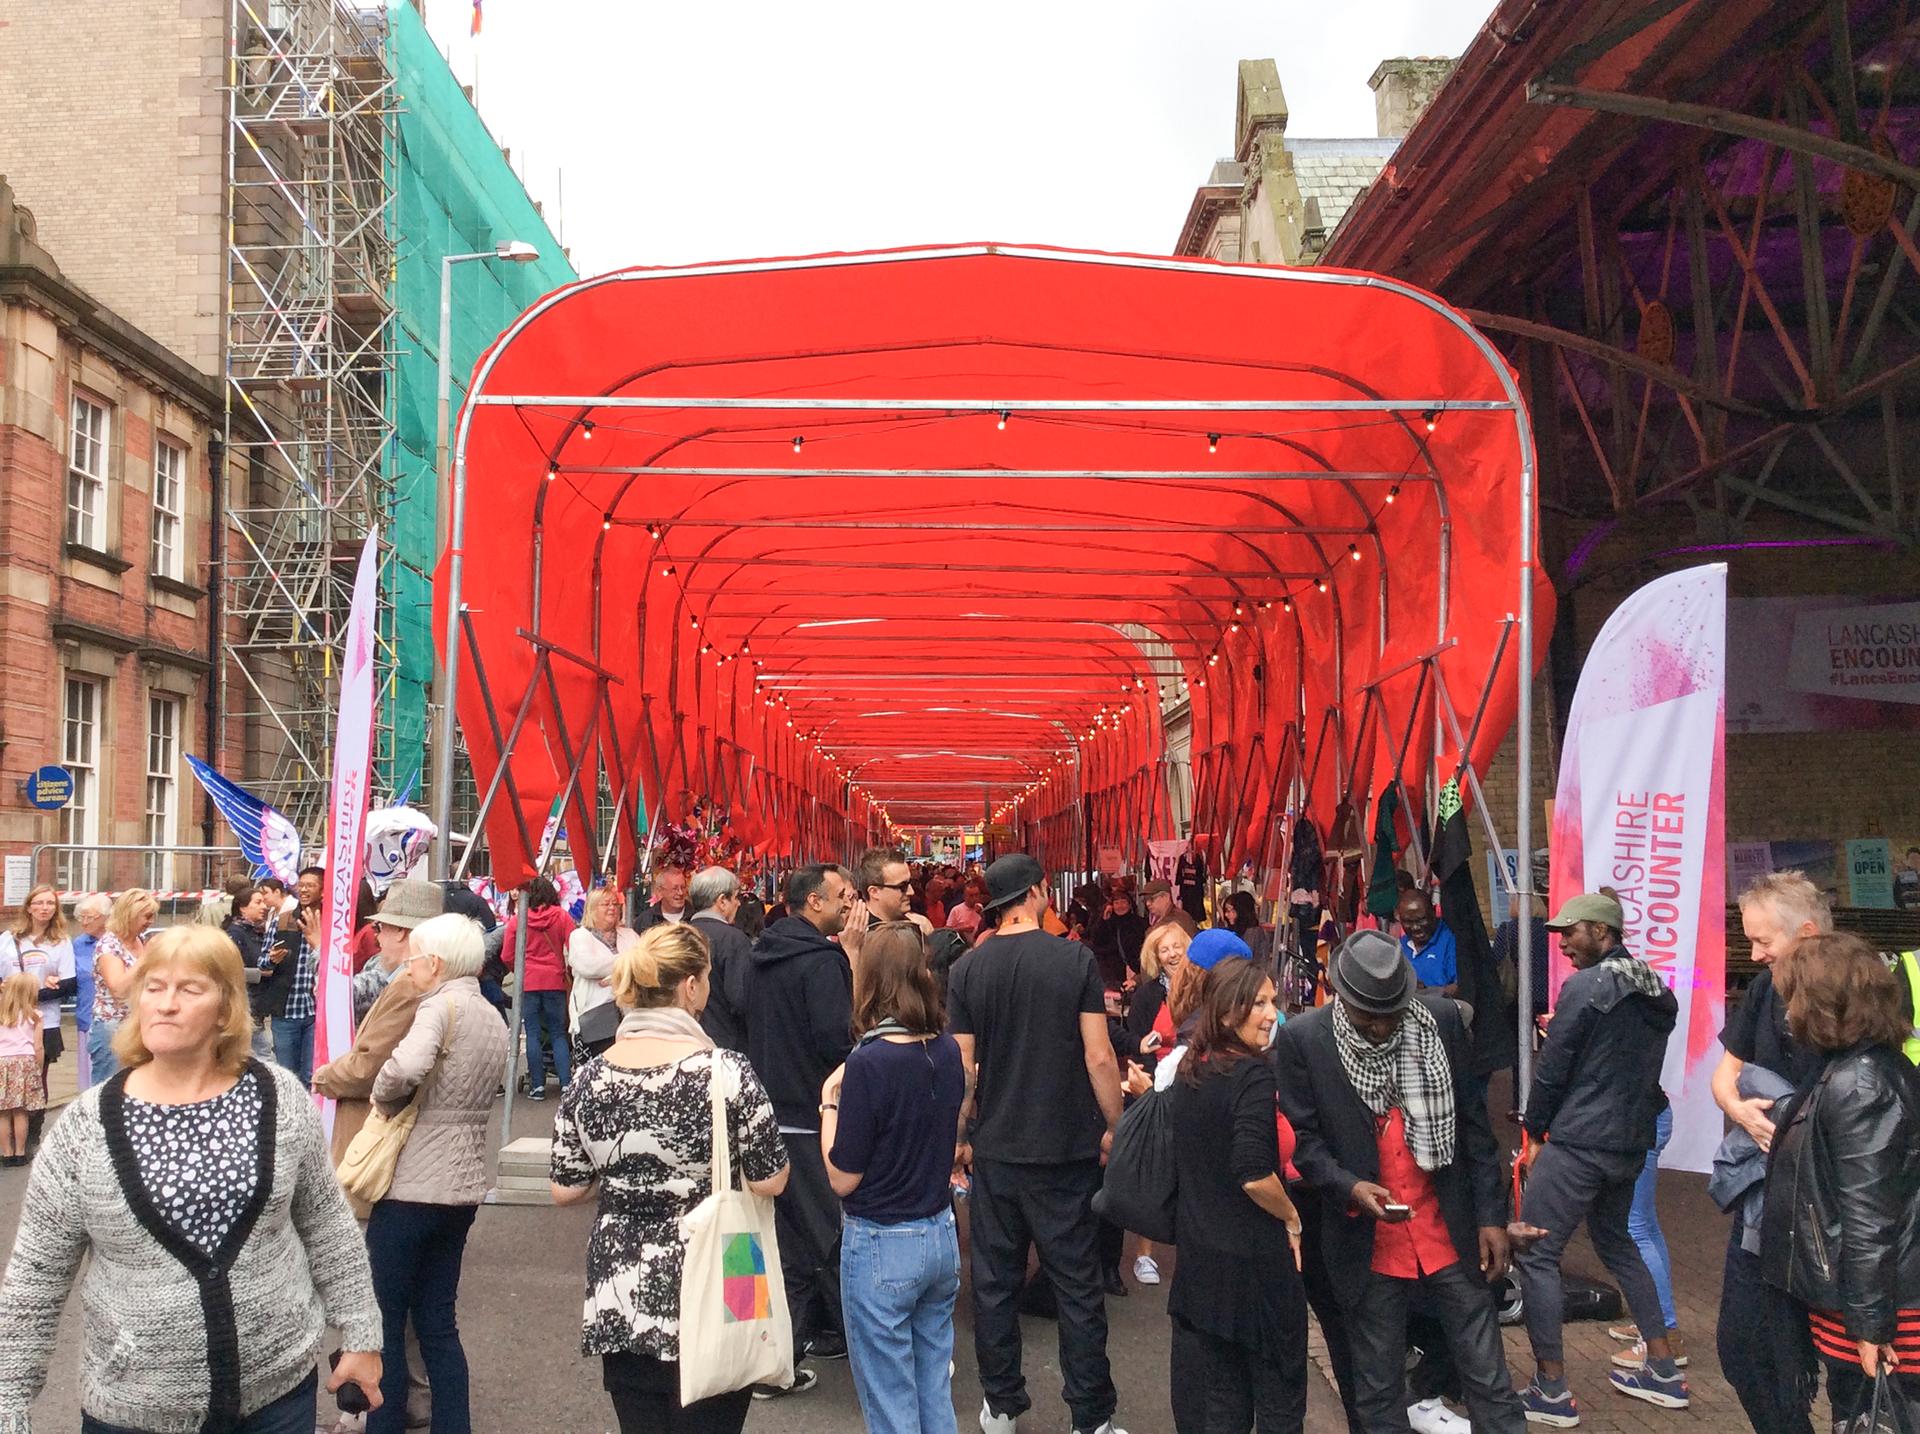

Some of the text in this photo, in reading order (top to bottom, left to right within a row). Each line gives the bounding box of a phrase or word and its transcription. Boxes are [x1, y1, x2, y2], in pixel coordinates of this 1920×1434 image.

[1829, 671, 1920, 686] #LancsEnc
[37, 787, 64, 796] advice
[1612, 789, 1649, 958] NCASHIRE
[1855, 861, 1885, 875] OPEN
